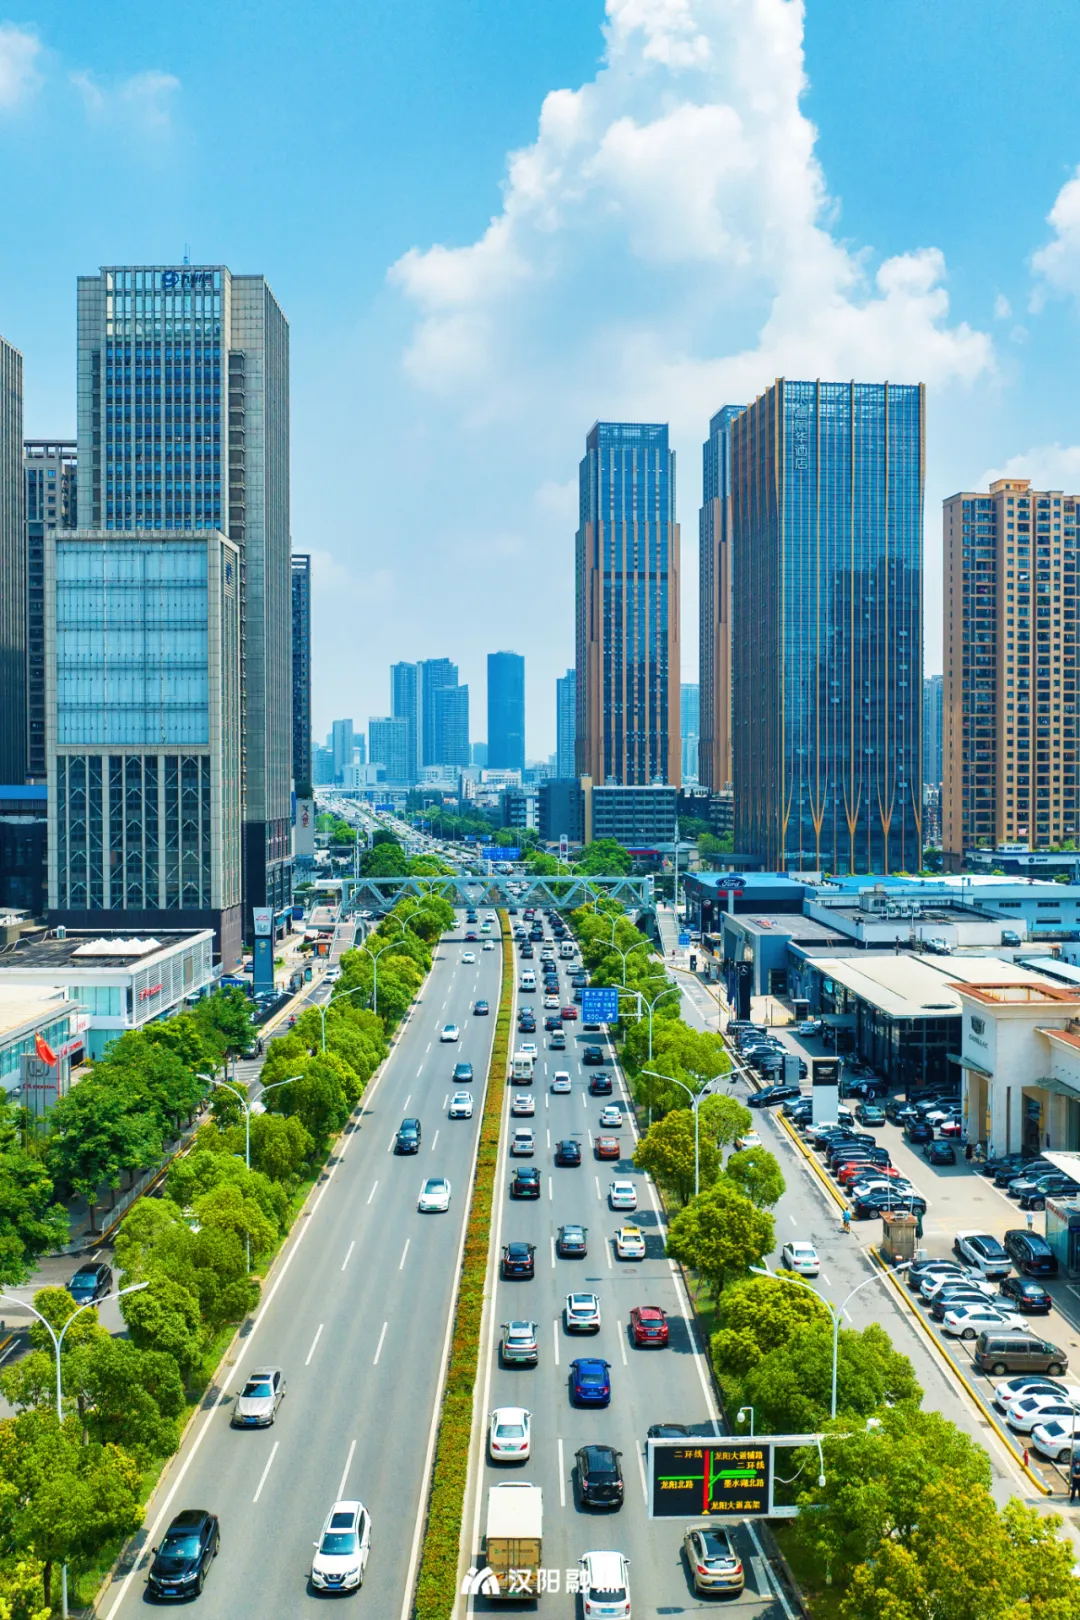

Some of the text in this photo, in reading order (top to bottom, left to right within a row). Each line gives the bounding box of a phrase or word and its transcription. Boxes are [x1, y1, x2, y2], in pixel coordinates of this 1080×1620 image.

[721, 879, 740, 888] Ford
[674, 1449, 703, 1459] 二环线
[736, 1461, 765, 1470] 二环线
[660, 1480, 694, 1490] 龙阳北路
[723, 1478, 765, 1489] 墨水湖北路
[710, 1500, 761, 1511] 龙阳大道高架
